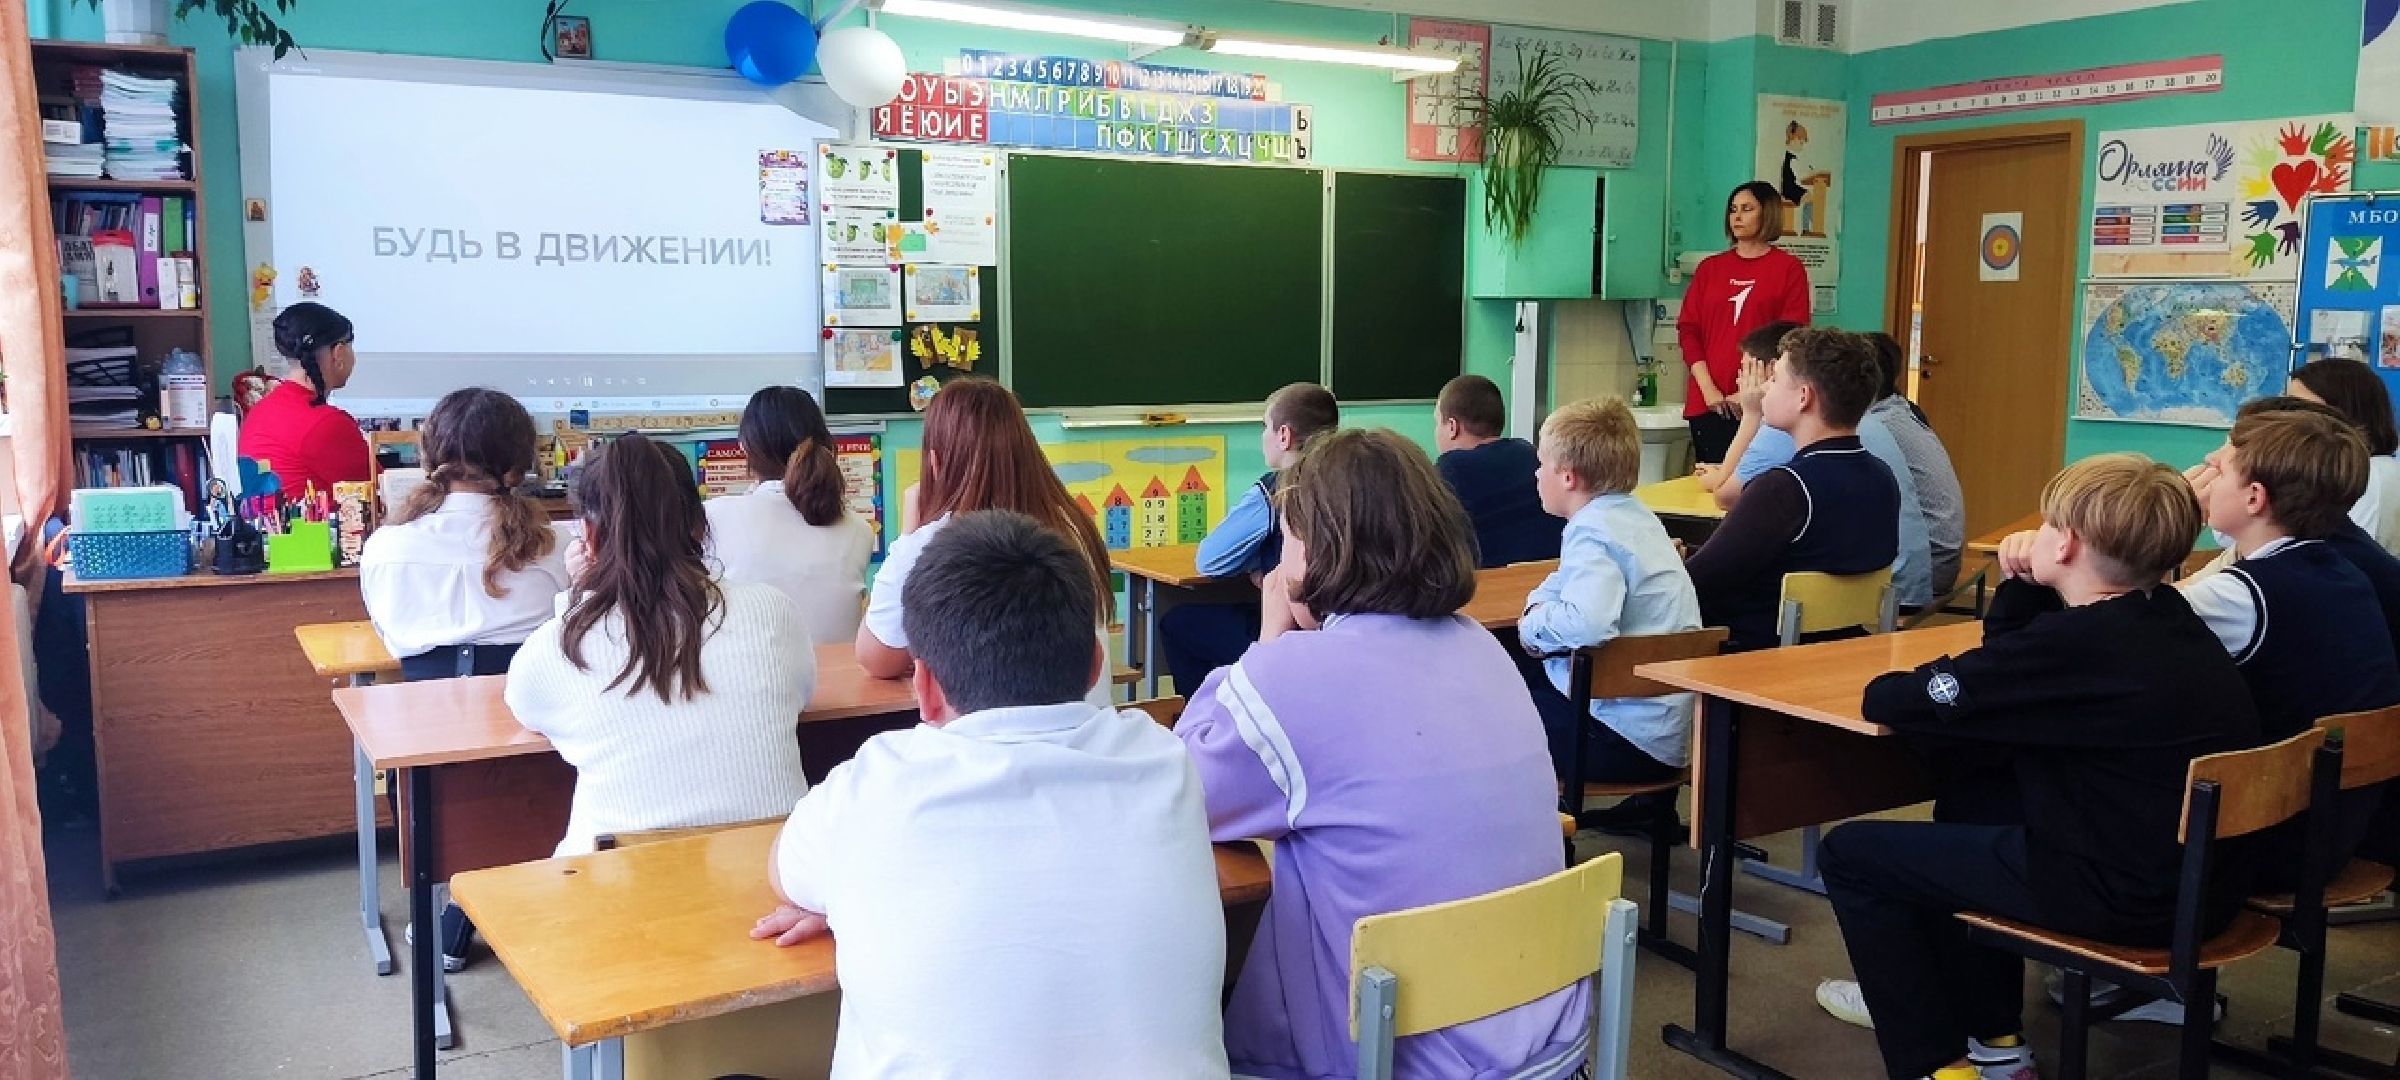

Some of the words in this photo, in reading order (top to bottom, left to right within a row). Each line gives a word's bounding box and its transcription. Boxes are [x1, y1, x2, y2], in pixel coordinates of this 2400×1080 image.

[962, 53, 971, 72] 0
[979, 56, 987, 74] 1
[992, 57, 1002, 76] 2
[1008, 57, 1017, 77] 3
[1022, 59, 1033, 77] 4
[1037, 60, 1047, 79] 5
[1051, 61, 1061, 80] 6
[1066, 62, 1076, 81] 7
[1080, 63, 1090, 82] 8
[1094, 64, 1103, 82] 9
[1106, 65, 1119, 84] 10
[1226, 76, 1238, 93] 18
[901, 78, 917, 102] О
[921, 77, 938, 102] У
[945, 79, 962, 106] Ы
[970, 81, 983, 107] Э
[990, 83, 1004, 106] Н
[1010, 84, 1030, 109] М
[1035, 87, 1050, 111] Л
[1059, 89, 1071, 113] Р
[1097, 94, 1111, 117] Б
[1120, 96, 1131, 119] В
[1158, 99, 1175, 125] Д
[1201, 102, 1212, 124] З
[877, 107, 891, 134] Я
[921, 109, 942, 136] Ю
[945, 111, 962, 137] И
[970, 113, 983, 139] Е
[1097, 124, 1111, 149] П
[1115, 126, 1135, 149] Ф
[1140, 127, 1152, 151] К
[1160, 129, 1172, 153] Т
[1178, 131, 1195, 154] Ш
[1200, 131, 1212, 154] С
[1218, 134, 1232, 155] Х
[1238, 133, 1251, 160] Ц
[1257, 134, 1270, 158] Ч
[1274, 136, 1291, 161] Щ
[2100, 139, 2208, 185] Орлята
[2349, 209, 2399, 224] МБО
[372, 226, 483, 264] БУДЬ
[495, 231, 522, 260] В
[535, 233, 772, 267] ДВИЖЕНИИ!
